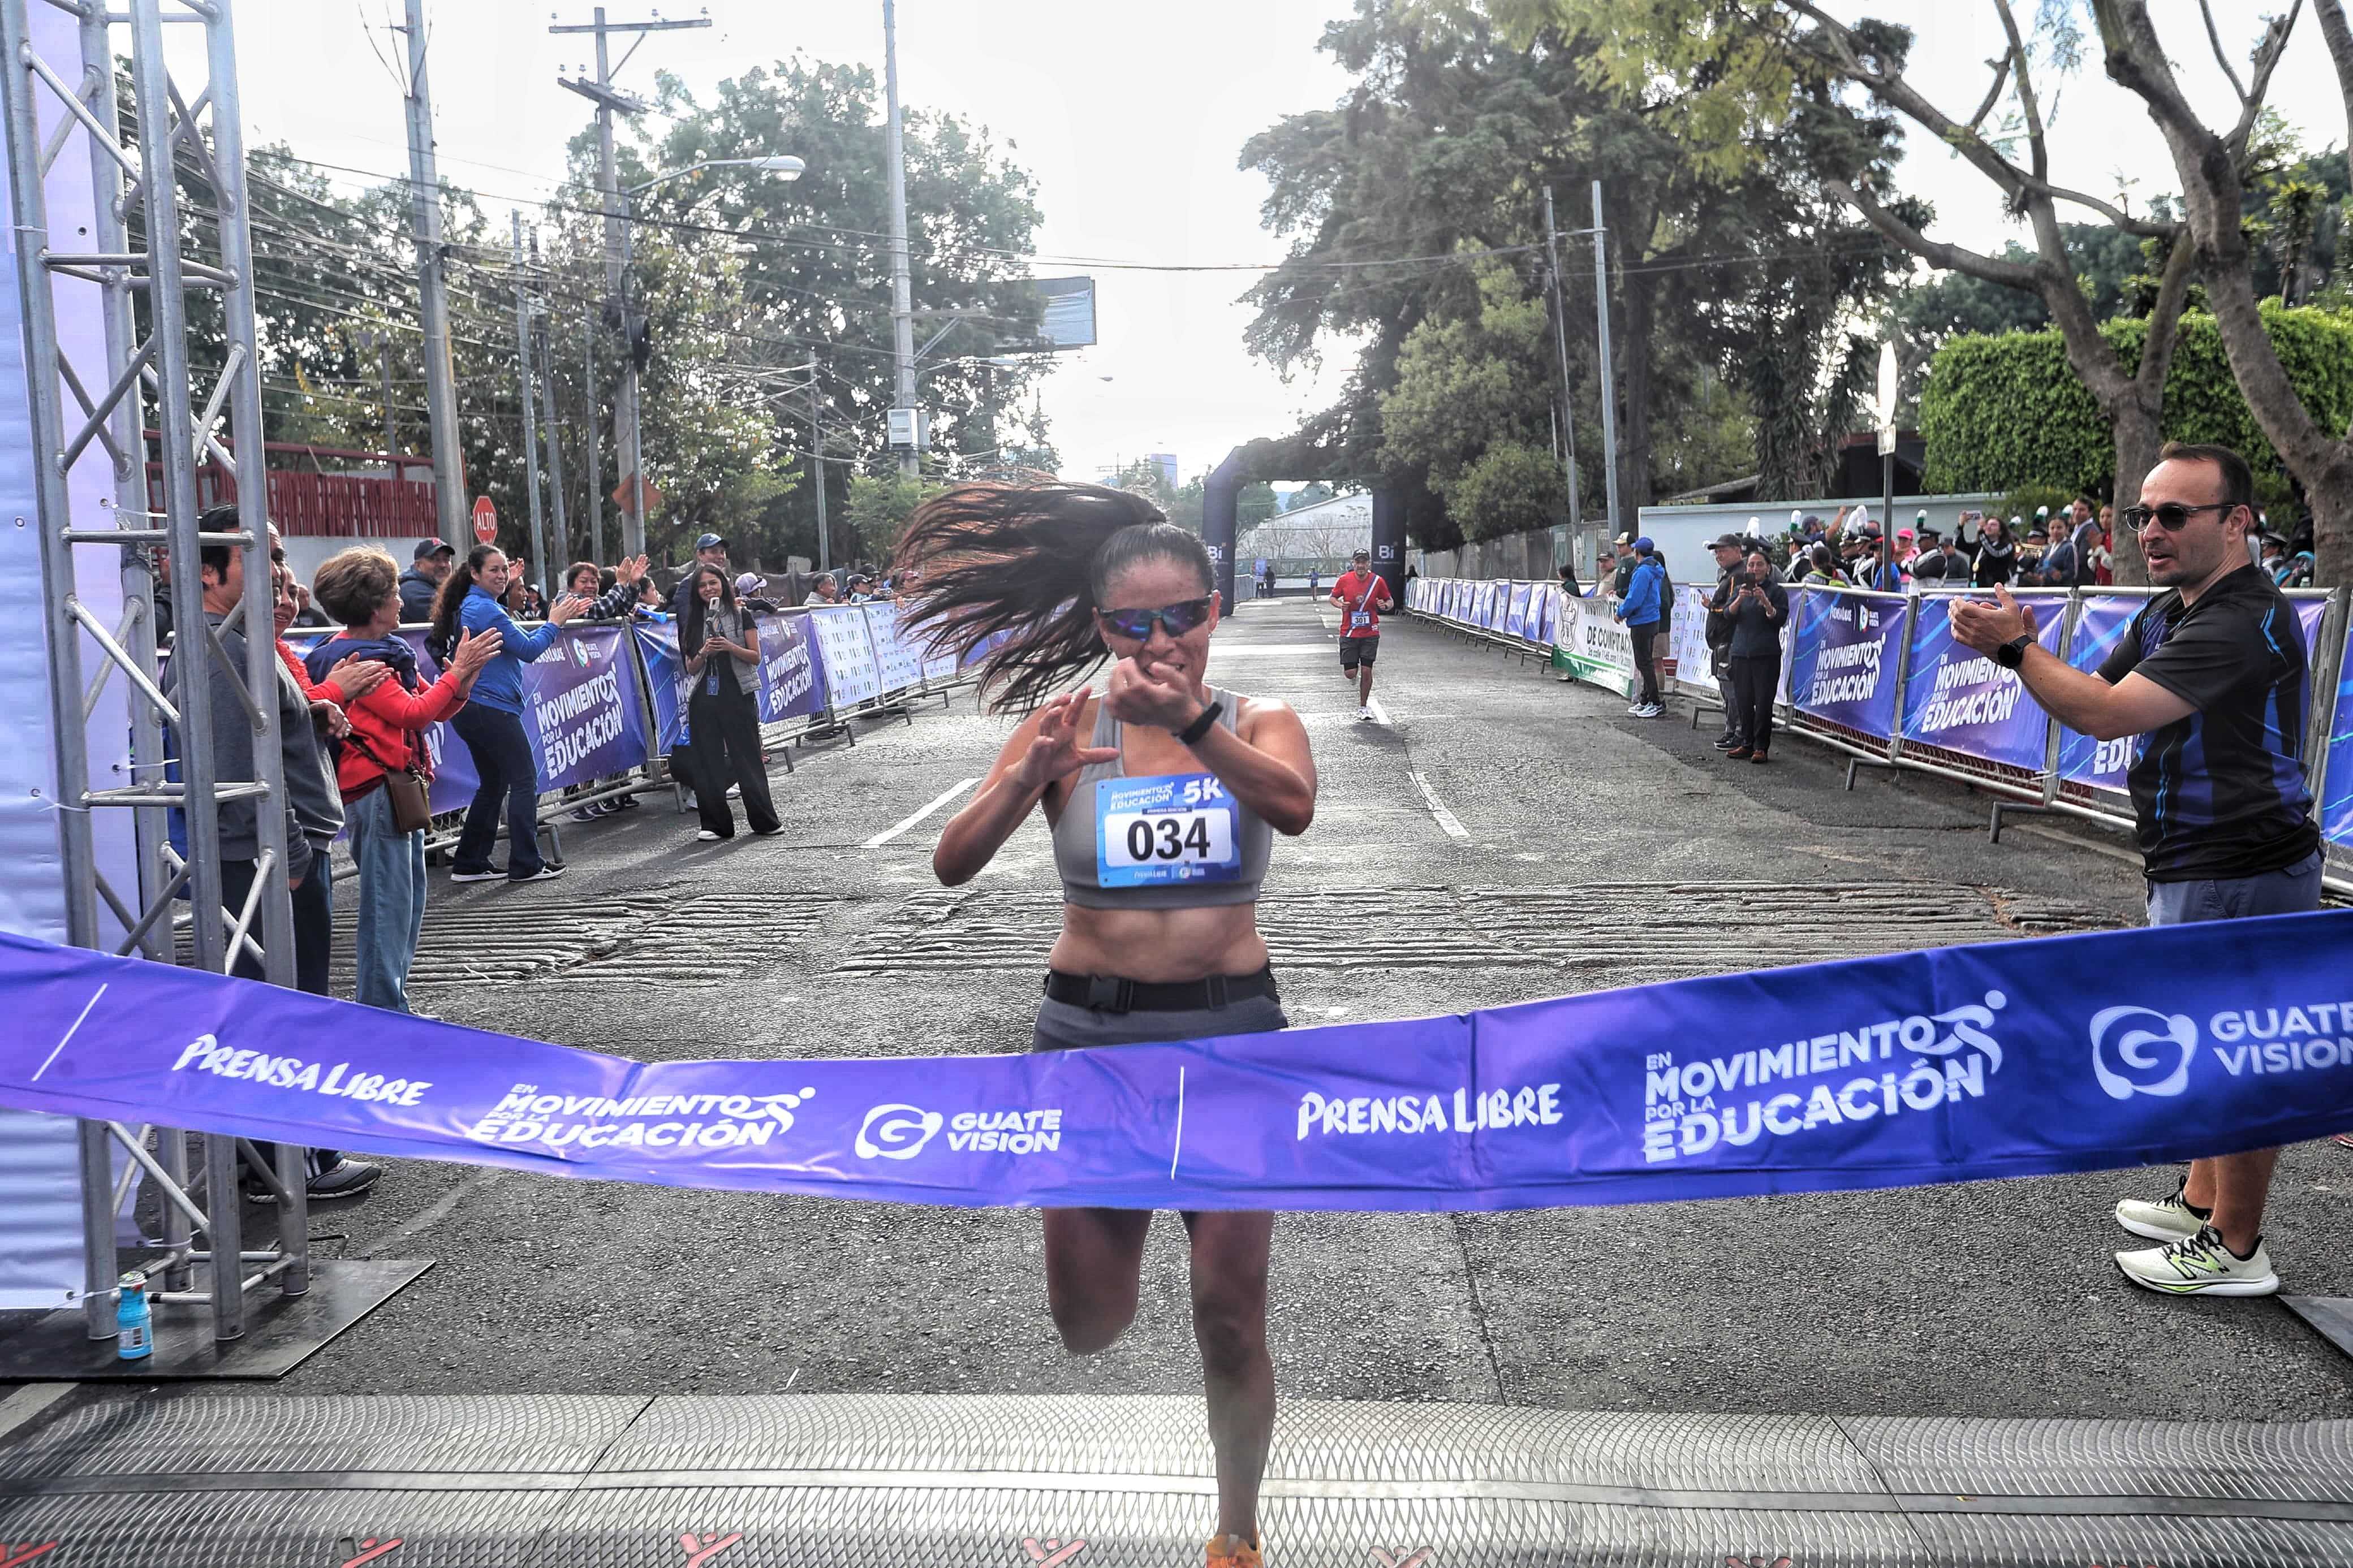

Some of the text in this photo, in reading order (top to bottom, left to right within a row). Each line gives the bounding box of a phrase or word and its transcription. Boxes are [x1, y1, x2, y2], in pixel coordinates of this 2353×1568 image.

[477, 512, 495, 530] ALTO
[1207, 545, 1222, 559] Bi
[1379, 545, 1394, 559] Bi
[1587, 625, 1597, 645] DE
[766, 645, 807, 684] MOVIMIENTO
[1817, 641, 1874, 671] MOVIMIENTO
[1940, 653, 1948, 666] EN
[533, 691, 542, 705] EN
[769, 666, 813, 715] EDUCACIÓN
[1811, 668, 1876, 706] EDUCACIÓN
[1943, 689, 1950, 702] LA
[535, 674, 609, 734] MOVIMIENTO
[1921, 683, 2016, 733] EDUCACIÓN
[542, 726, 563, 747] POR LA
[544, 705, 623, 780] EDUCACIÓN
[1183, 776, 1225, 804] 5K
[1127, 817, 1210, 861] 034
[172, 1033, 434, 1107] PRENSA LIBRE
[1645, 1015, 1937, 1106] MOVIMIENTO
[1647, 1051, 1672, 1071] EN
[510, 1083, 538, 1094] EN
[484, 1111, 551, 1122] POR LA
[495, 1094, 753, 1118] MOVIMIENTO
[1297, 1083, 1563, 1141] PRENSA LIBRE
[1642, 1054, 1986, 1163] EDUCACIÓN
[1645, 1097, 1716, 1122] POR LA
[464, 1118, 778, 1148] EDUCACIÓN
[951, 1109, 1063, 1132] GUATE
[946, 1131, 1062, 1154] VISION
